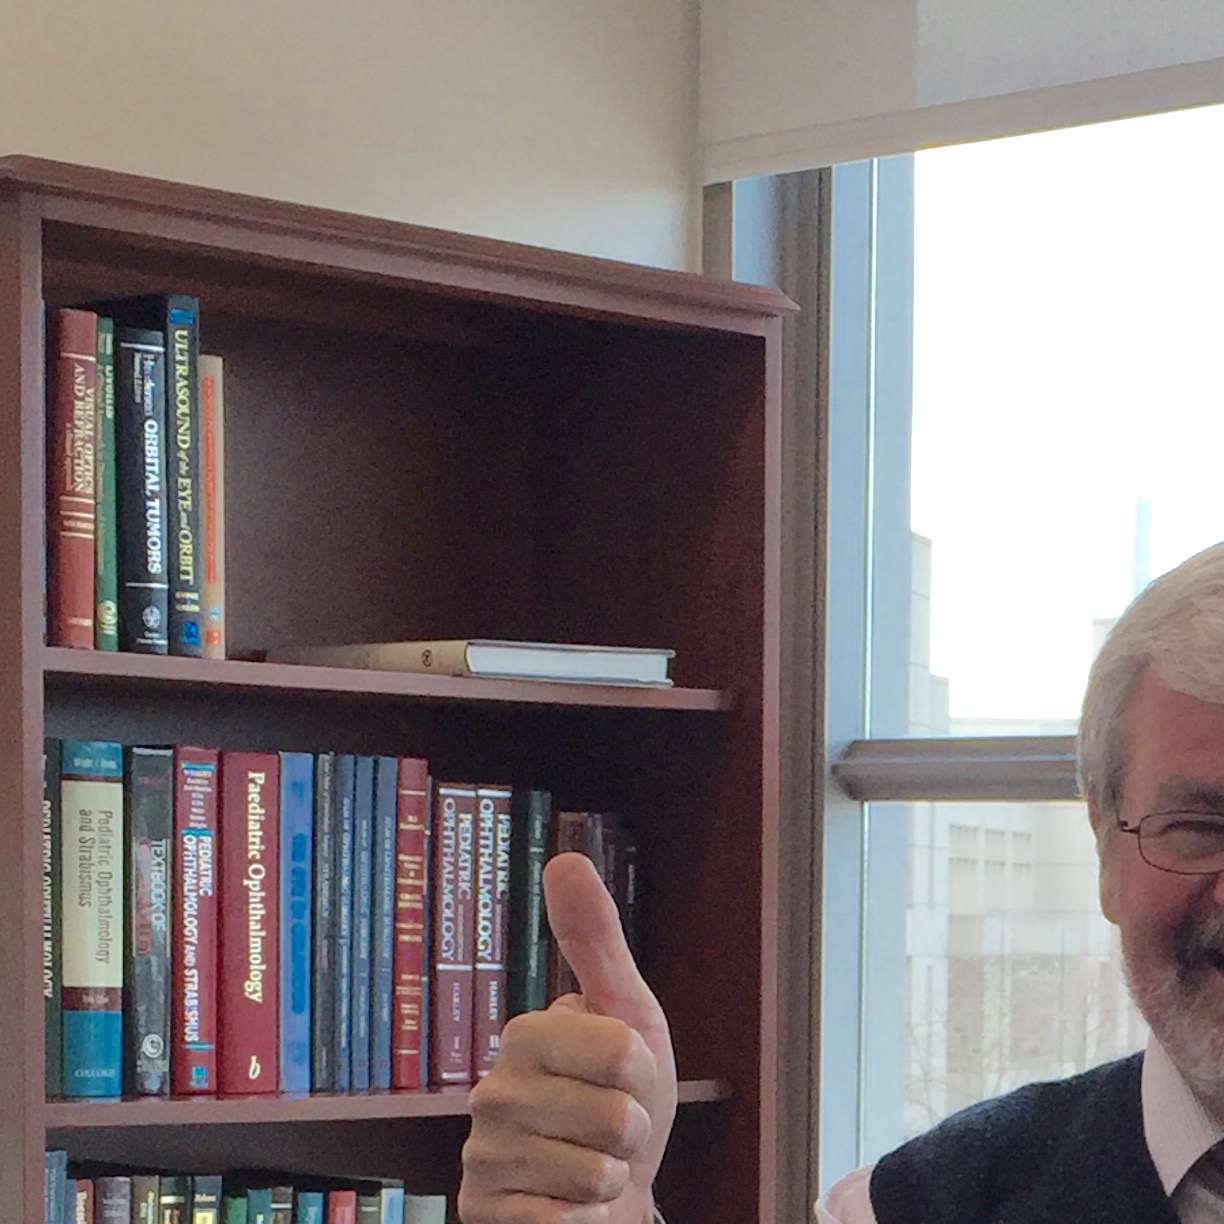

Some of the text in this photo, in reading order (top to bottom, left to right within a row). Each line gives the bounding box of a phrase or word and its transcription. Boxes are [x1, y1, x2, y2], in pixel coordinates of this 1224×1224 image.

[73, 363, 87, 494] AND REFRACTION
[174, 329, 191, 450] ULTRASOUND
[84, 387, 96, 494] VISUAL OPTICS
[143, 418, 160, 496] ORBITAL
[146, 499, 162, 575] TUMORS
[177, 477, 193, 512] EYE
[178, 528, 195, 586] ORBIT
[77, 808, 96, 908] and Strabismus
[94, 810, 114, 964] Pediatric Ophthalmology
[150, 838, 167, 908] TEXTBOOK
[182, 834, 199, 945] OPHTHALMOLOGY
[198, 836, 213, 897] PEDIATRIC
[242, 770, 268, 1004] Paediatric Ophthalmology
[442, 798, 456, 962] OPHTHALMOLOGY
[458, 813, 473, 900] PEDIATRIC
[497, 813, 511, 900] PEDIATRIC
[477, 798, 499, 1021] OPHTHALMOLOGY HARLEY
[182, 968, 199, 1043] STRABISMUS
